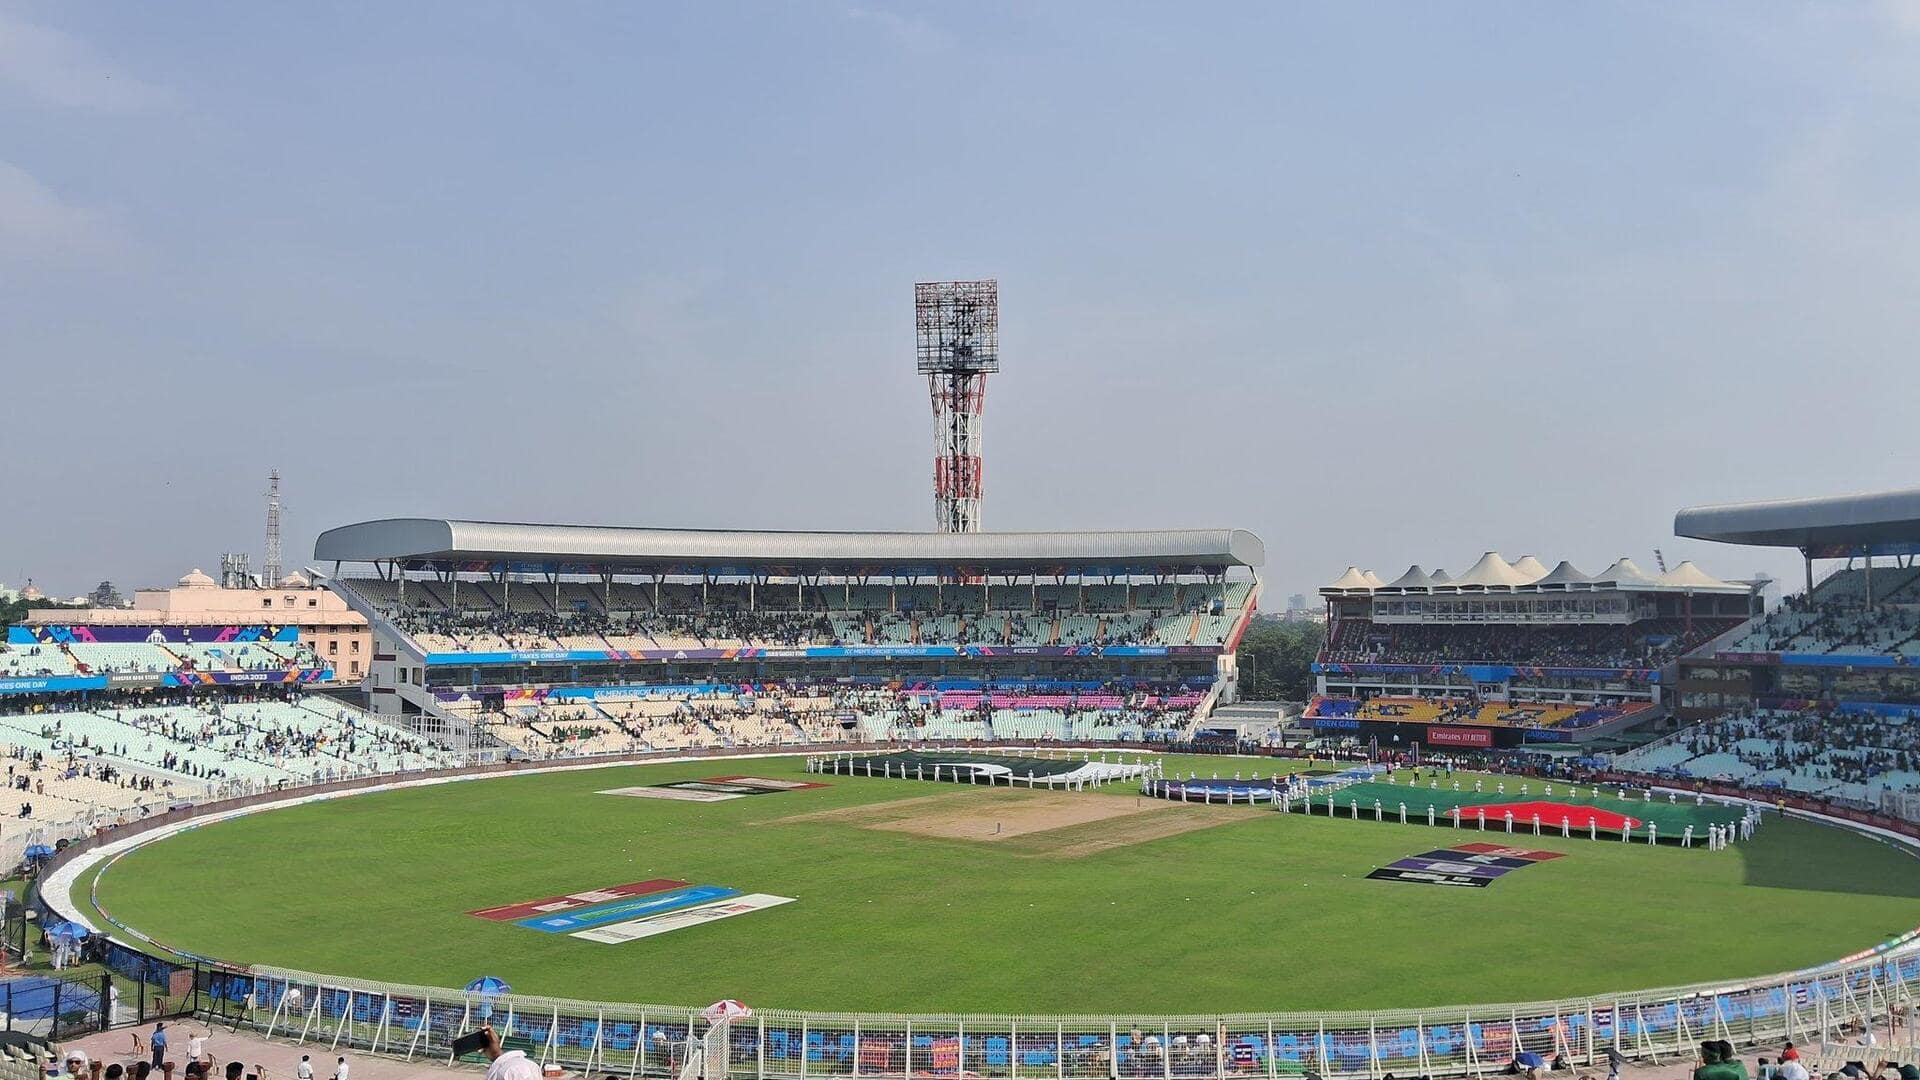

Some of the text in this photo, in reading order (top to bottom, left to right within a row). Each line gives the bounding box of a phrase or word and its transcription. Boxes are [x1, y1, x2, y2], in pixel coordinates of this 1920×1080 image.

[250, 673, 268, 681] 2023
[15, 681, 31, 689] ONE
[32, 680, 48, 689] DAY
[1432, 731, 1461, 741] Emirates
